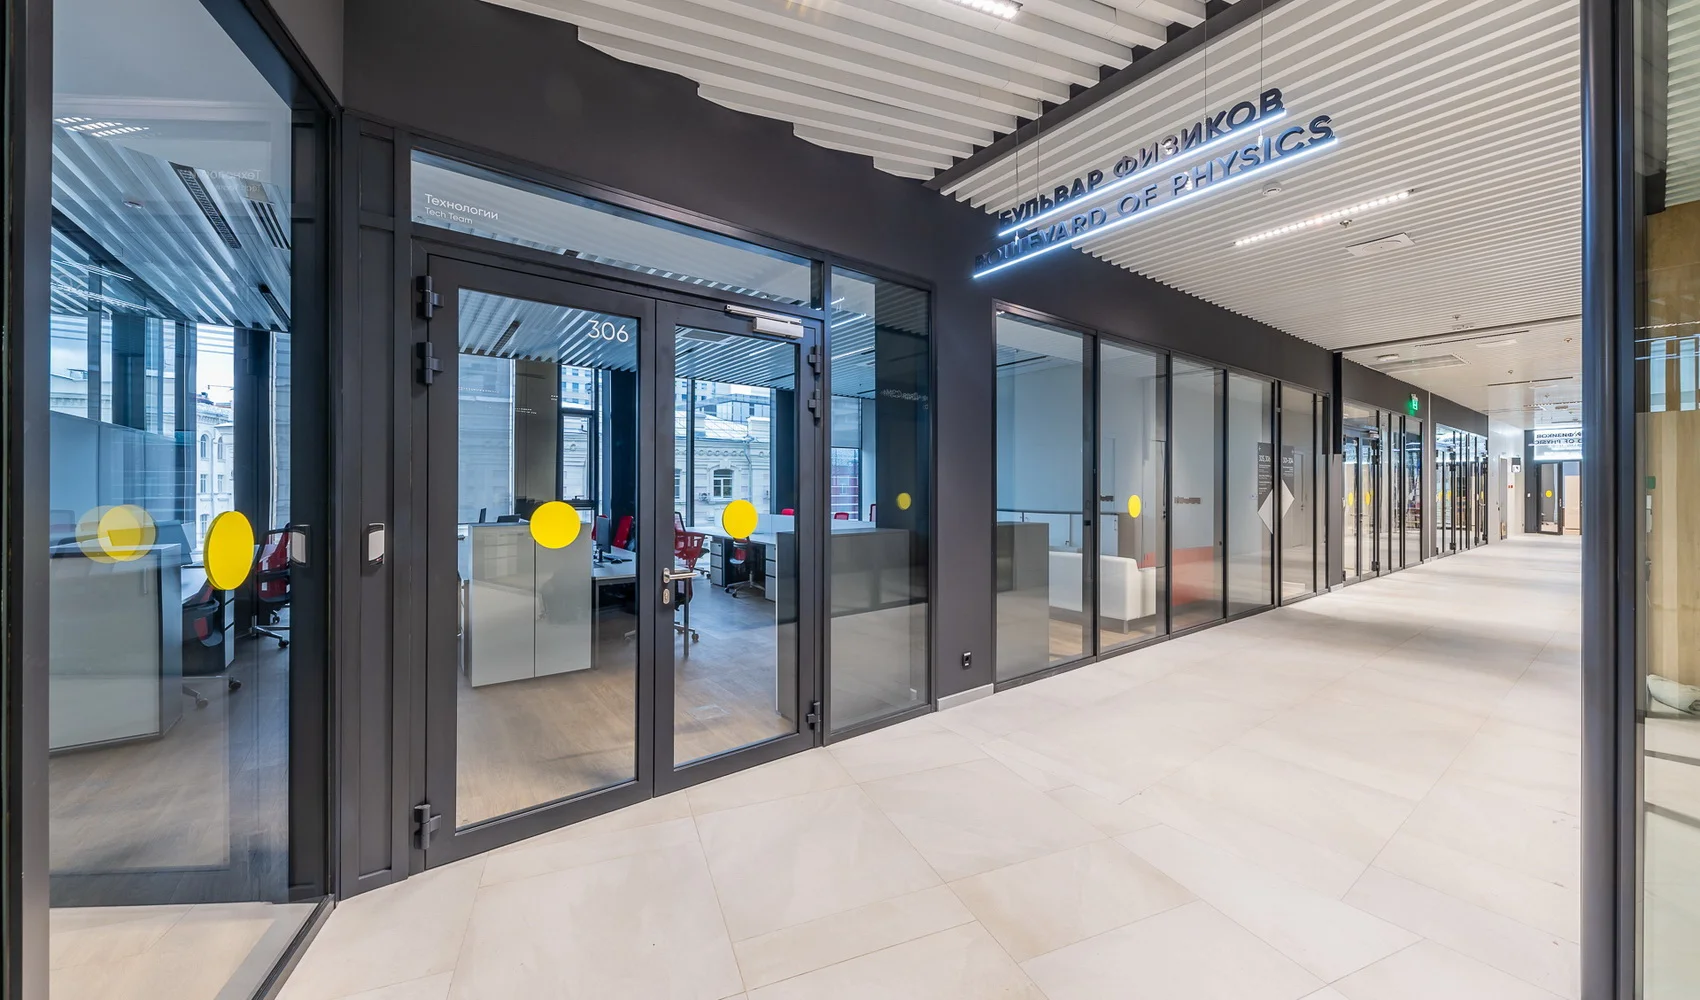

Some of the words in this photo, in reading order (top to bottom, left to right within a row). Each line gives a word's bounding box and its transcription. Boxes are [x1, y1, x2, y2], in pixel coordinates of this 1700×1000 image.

[999, 169, 1104, 227] БУЛЬВАР
[1113, 87, 1286, 178] ФИЗИКОВ
[1116, 183, 1158, 217] OF
[1170, 114, 1335, 197] PHYSICS
[424, 193, 499, 220] Технологии
[424, 206, 447, 218] Tech
[448, 211, 473, 225] Team
[588, 319, 629, 343] 306
